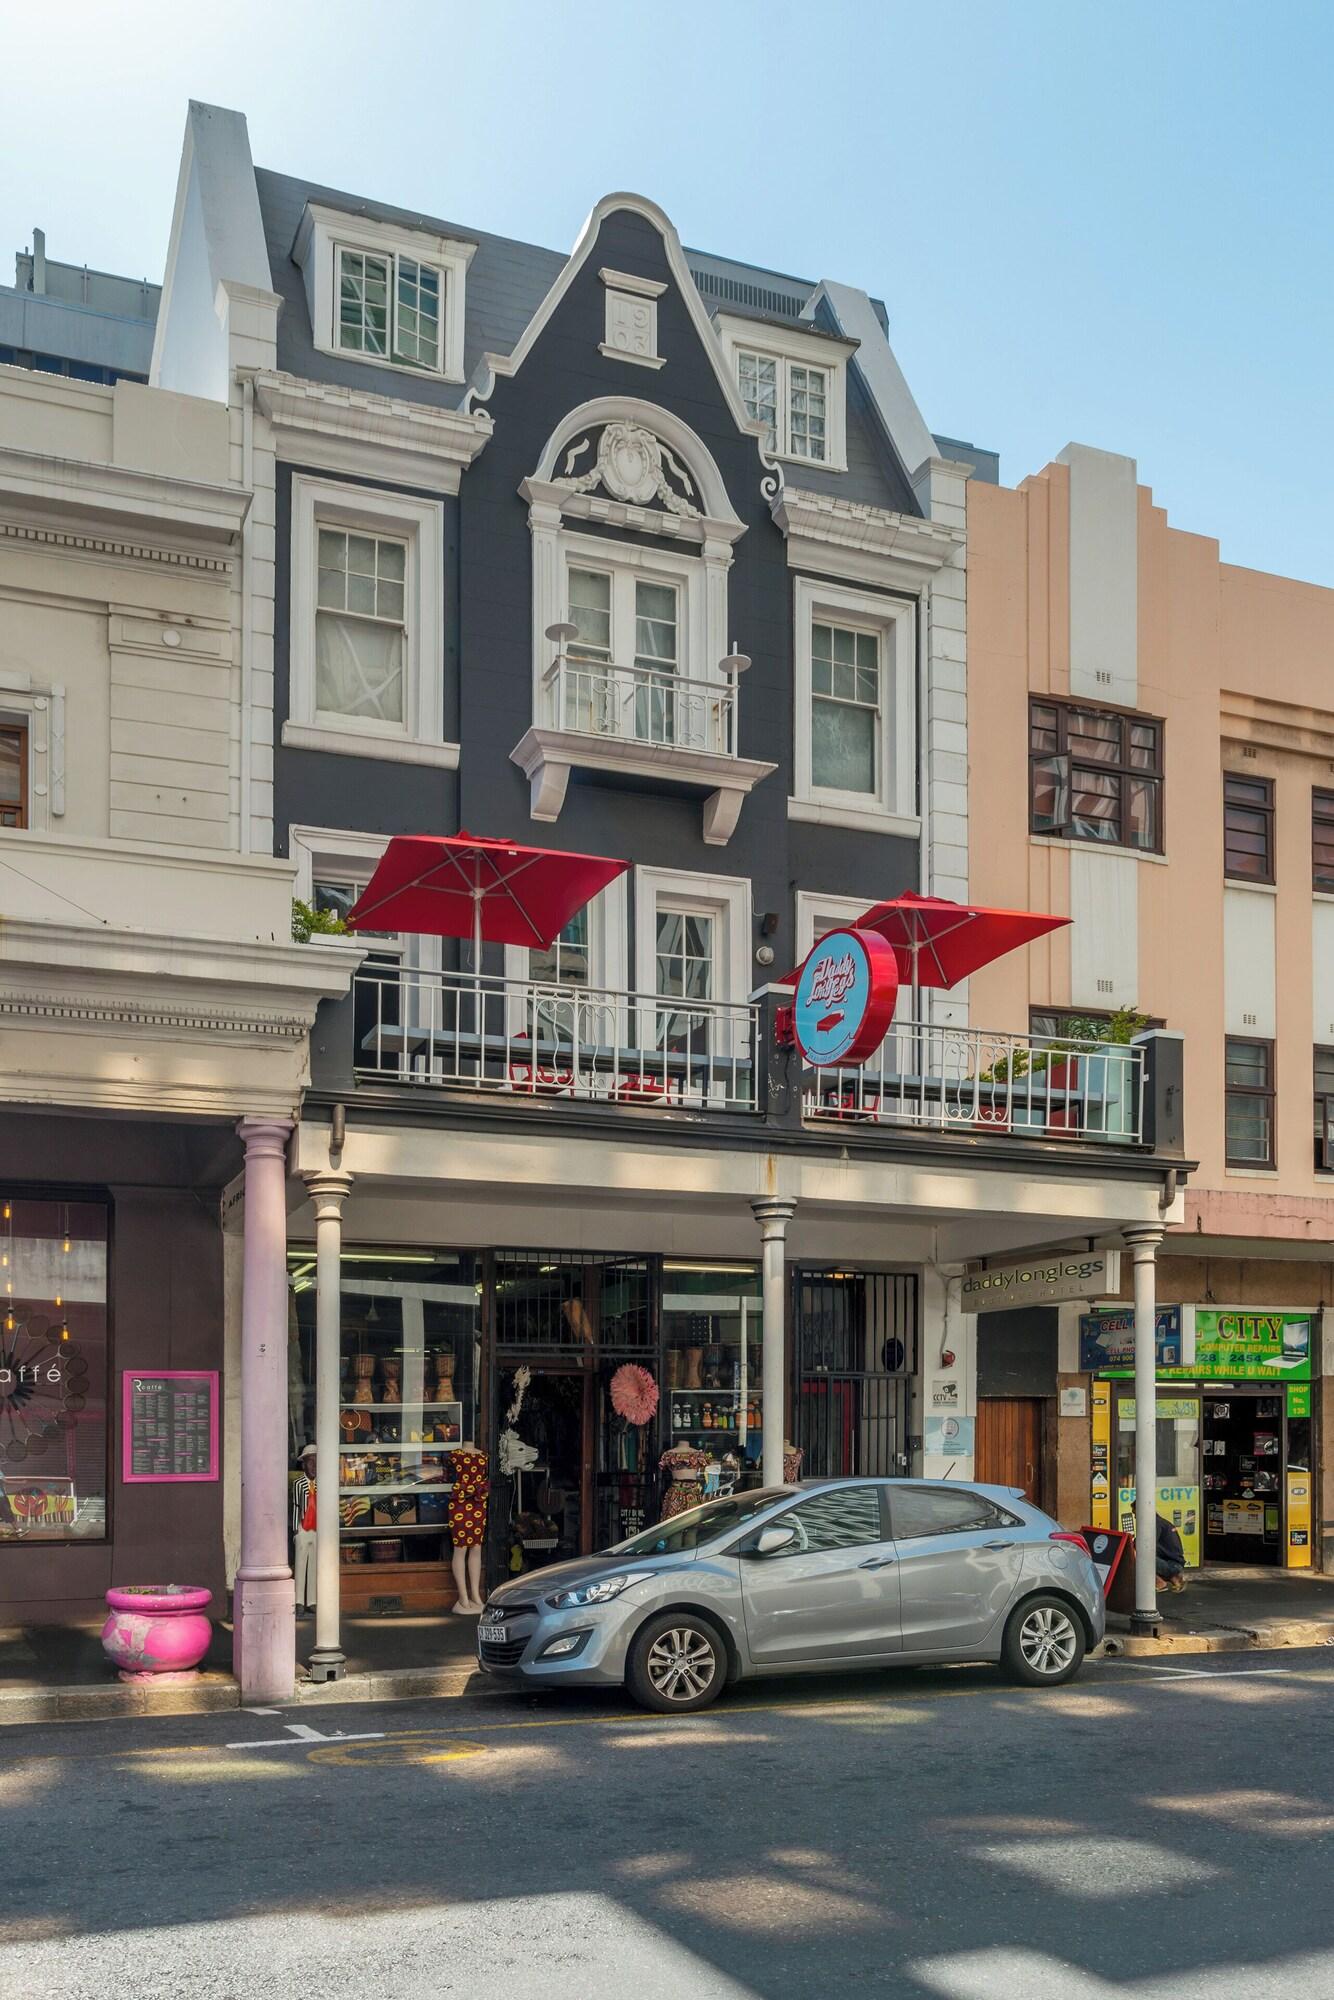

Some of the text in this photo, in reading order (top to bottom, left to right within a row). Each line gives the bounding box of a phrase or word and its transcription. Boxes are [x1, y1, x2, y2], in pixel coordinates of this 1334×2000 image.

[963, 1260, 1104, 1293] daddylonglegs
[1100, 1318, 1129, 1332] CELL
[1217, 1315, 1282, 1341] CITY
[1199, 1343, 1281, 1353] COMPUTER REPAIRS
[1229, 1354, 1262, 1362] 2454
[1168, 1365, 1211, 1376] REPAIRS
[1214, 1365, 1245, 1376] WHILE
[1247, 1366, 1255, 1375] U
[1257, 1366, 1281, 1376] WAIT
[933, 1393, 947, 1401] CCTV
[1160, 1487, 1193, 1501] CITY
